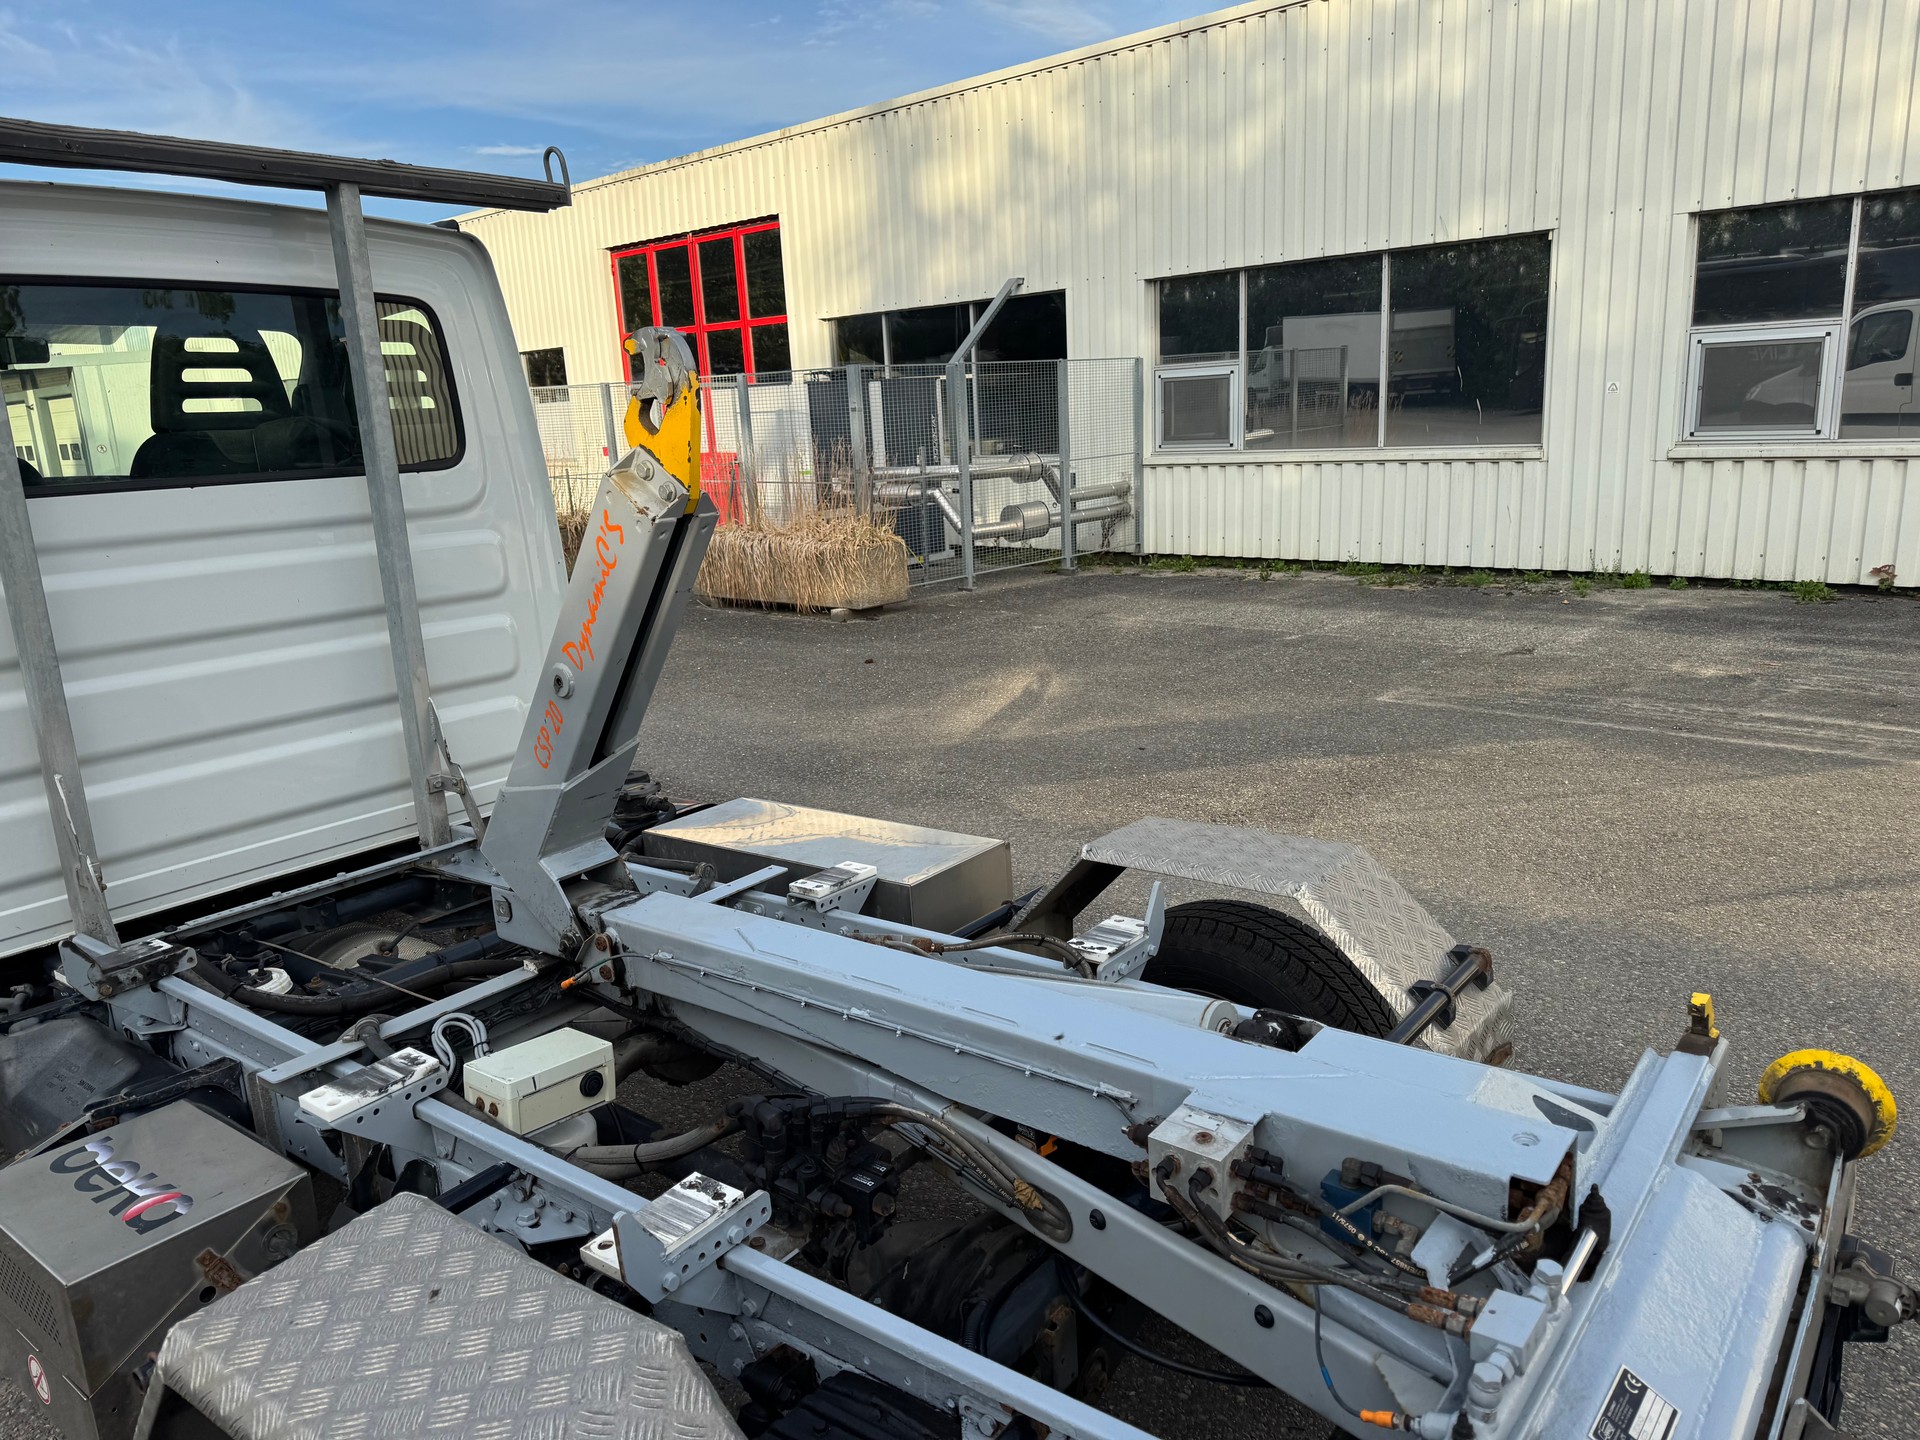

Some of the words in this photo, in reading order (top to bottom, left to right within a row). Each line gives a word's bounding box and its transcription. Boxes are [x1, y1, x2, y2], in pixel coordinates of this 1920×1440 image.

[534, 726, 555, 769] CSP
[545, 699, 564, 737] 20
[50, 1135, 194, 1236] beka
